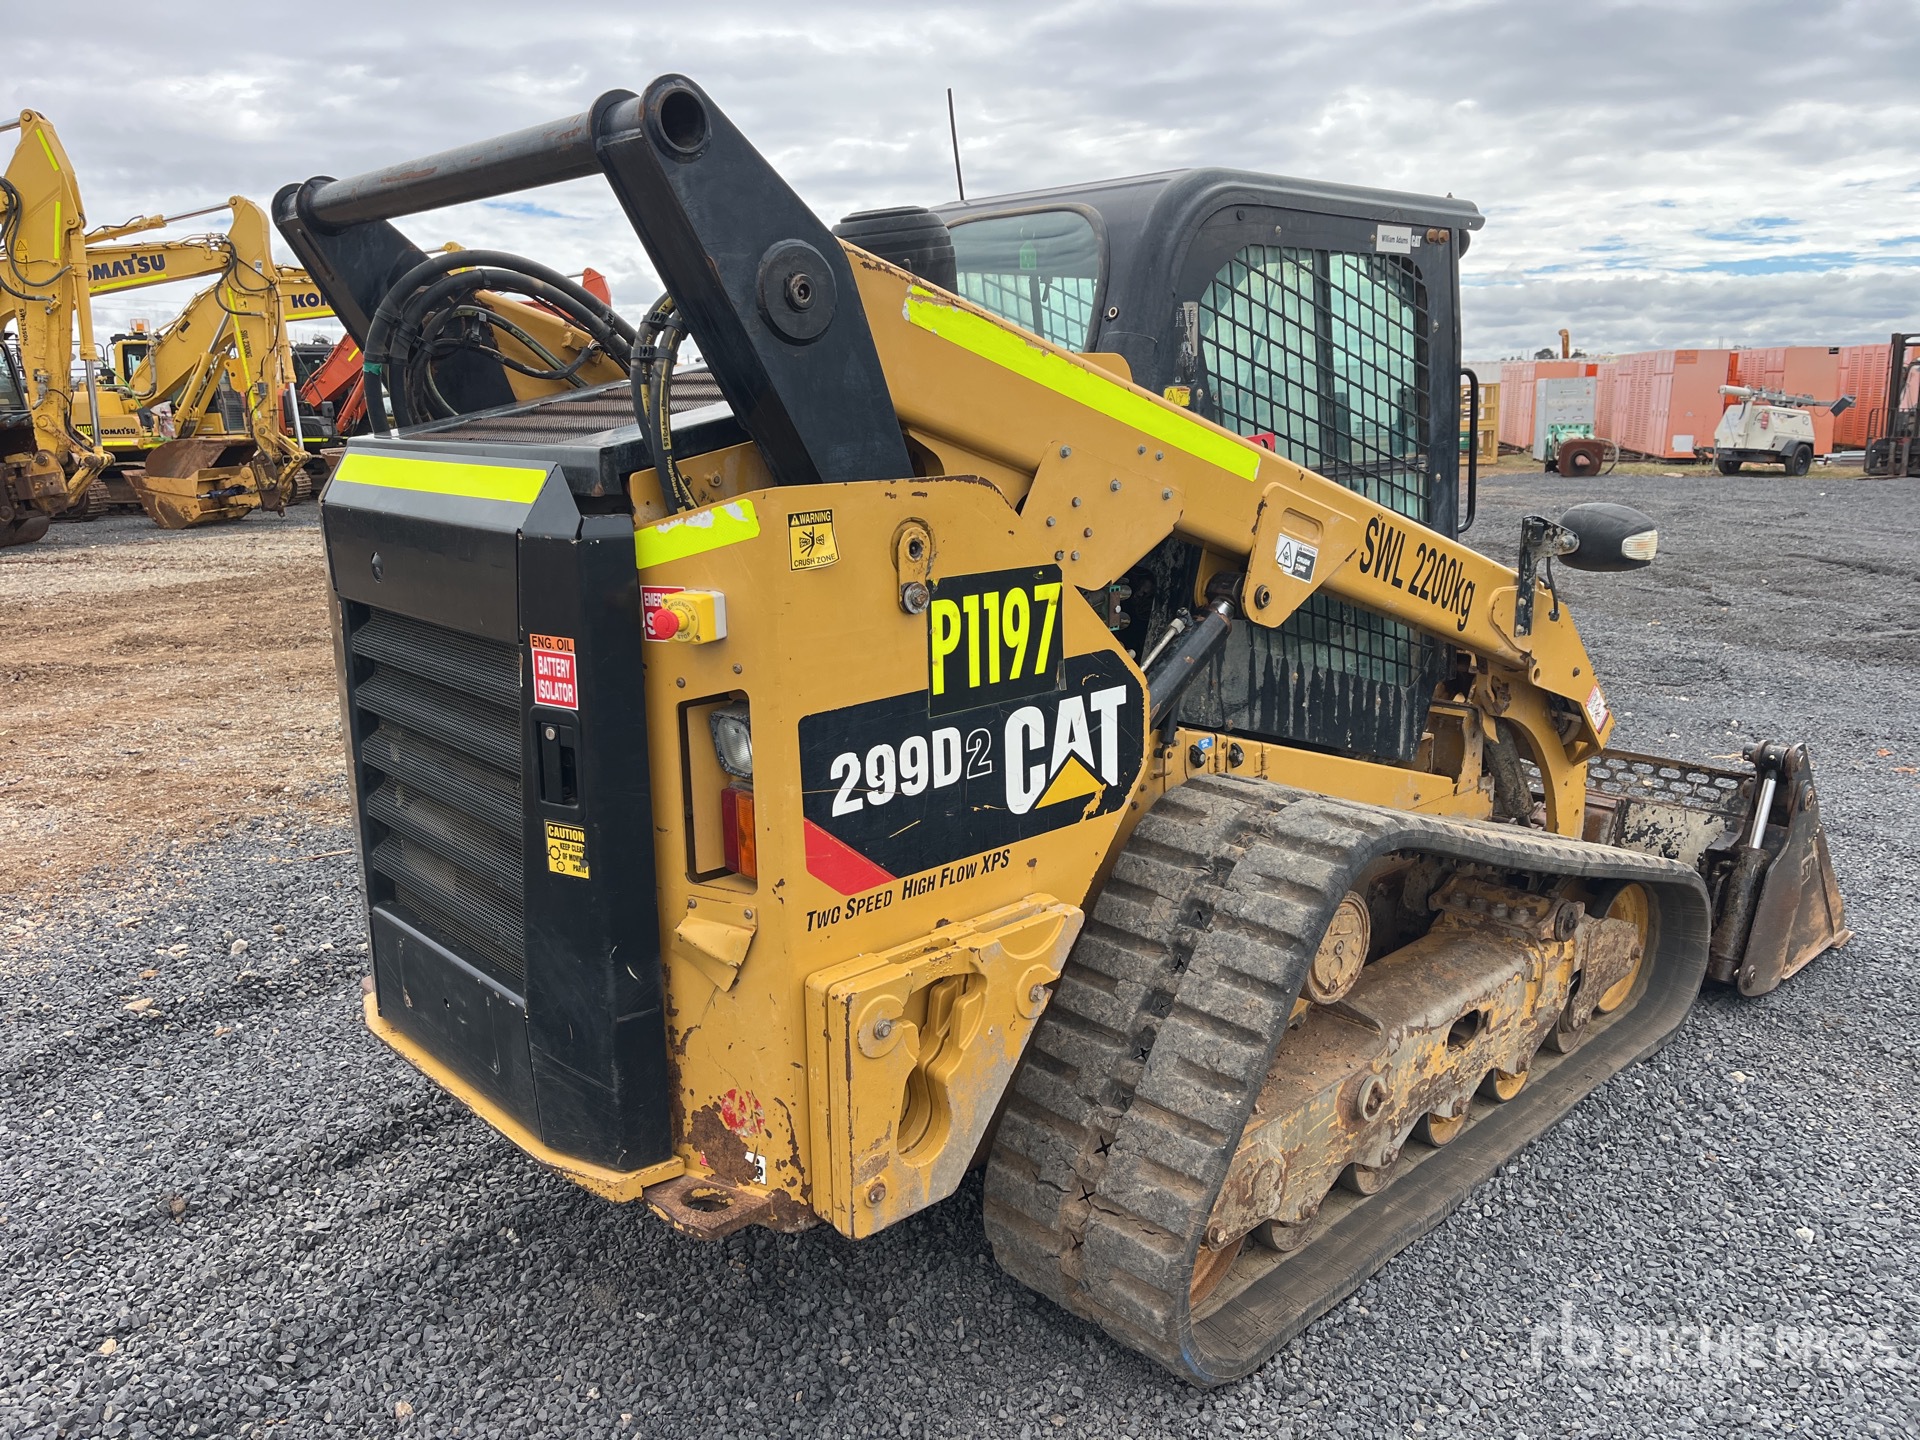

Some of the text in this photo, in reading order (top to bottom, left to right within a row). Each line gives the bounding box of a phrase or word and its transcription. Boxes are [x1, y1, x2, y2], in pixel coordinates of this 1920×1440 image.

[799, 511, 831, 525] WARNING
[793, 553, 836, 568] CRUSH ZONE
[1359, 516, 1476, 632] SWL 2200kg
[531, 635, 573, 652] ENG. OIL
[931, 582, 1063, 696] P1197
[537, 655, 570, 679] BATTERY
[537, 679, 574, 704] ISOLATOR
[1004, 684, 1128, 815] CAT
[548, 825, 585, 842] CAUTION
[980, 848, 1011, 875] XPS
